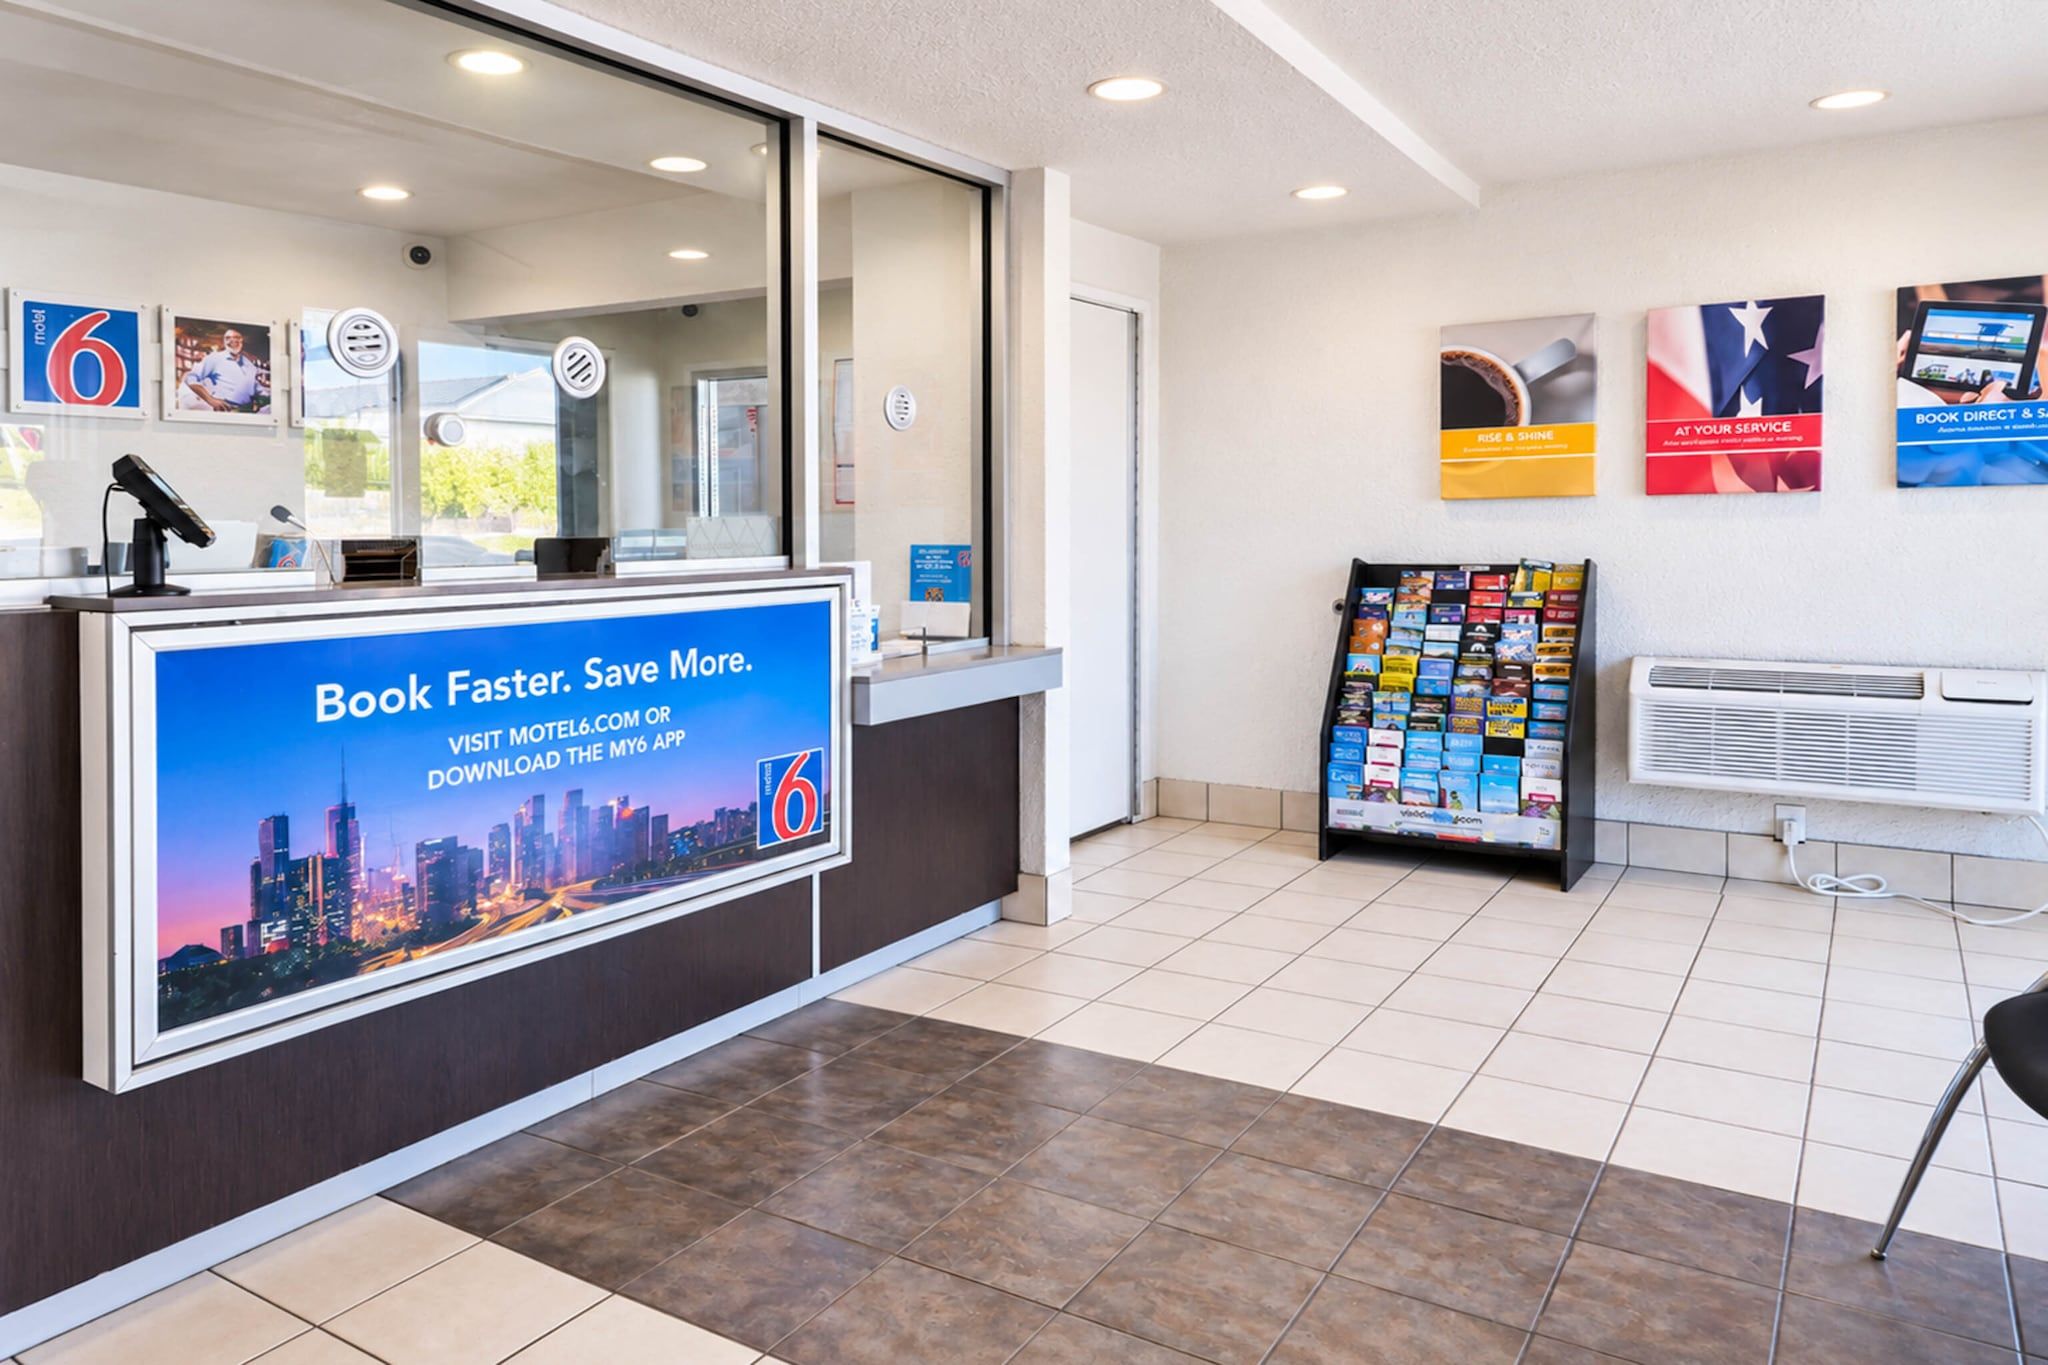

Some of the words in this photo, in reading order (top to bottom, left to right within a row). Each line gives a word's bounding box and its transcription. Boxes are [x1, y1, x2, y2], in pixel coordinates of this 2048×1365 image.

[31, 308, 46, 346] motel
[46, 310, 127, 406] 6
[1478, 432, 1502, 443] RISE
[1505, 432, 1515, 442] &
[1518, 430, 1554, 441] SHINE
[1674, 426, 1691, 437] AT
[1693, 424, 1732, 435] YOUR
[1734, 421, 1792, 434] SERVICE
[1916, 413, 1959, 424] BOOK
[1963, 409, 2016, 422] DIRECT
[2021, 408, 2033, 418] &
[317, 674, 431, 722] Book
[449, 670, 570, 705] Faster.
[585, 658, 658, 689] Save
[671, 648, 752, 679] More.
[449, 730, 502, 754] VISIT
[509, 711, 640, 746] MOTEL6.COM
[645, 706, 671, 724] OR
[428, 752, 561, 790] DOWNLOAD
[566, 743, 602, 764] THE
[610, 736, 647, 757] MY6
[653, 730, 685, 750] APP
[772, 752, 818, 842] 6
